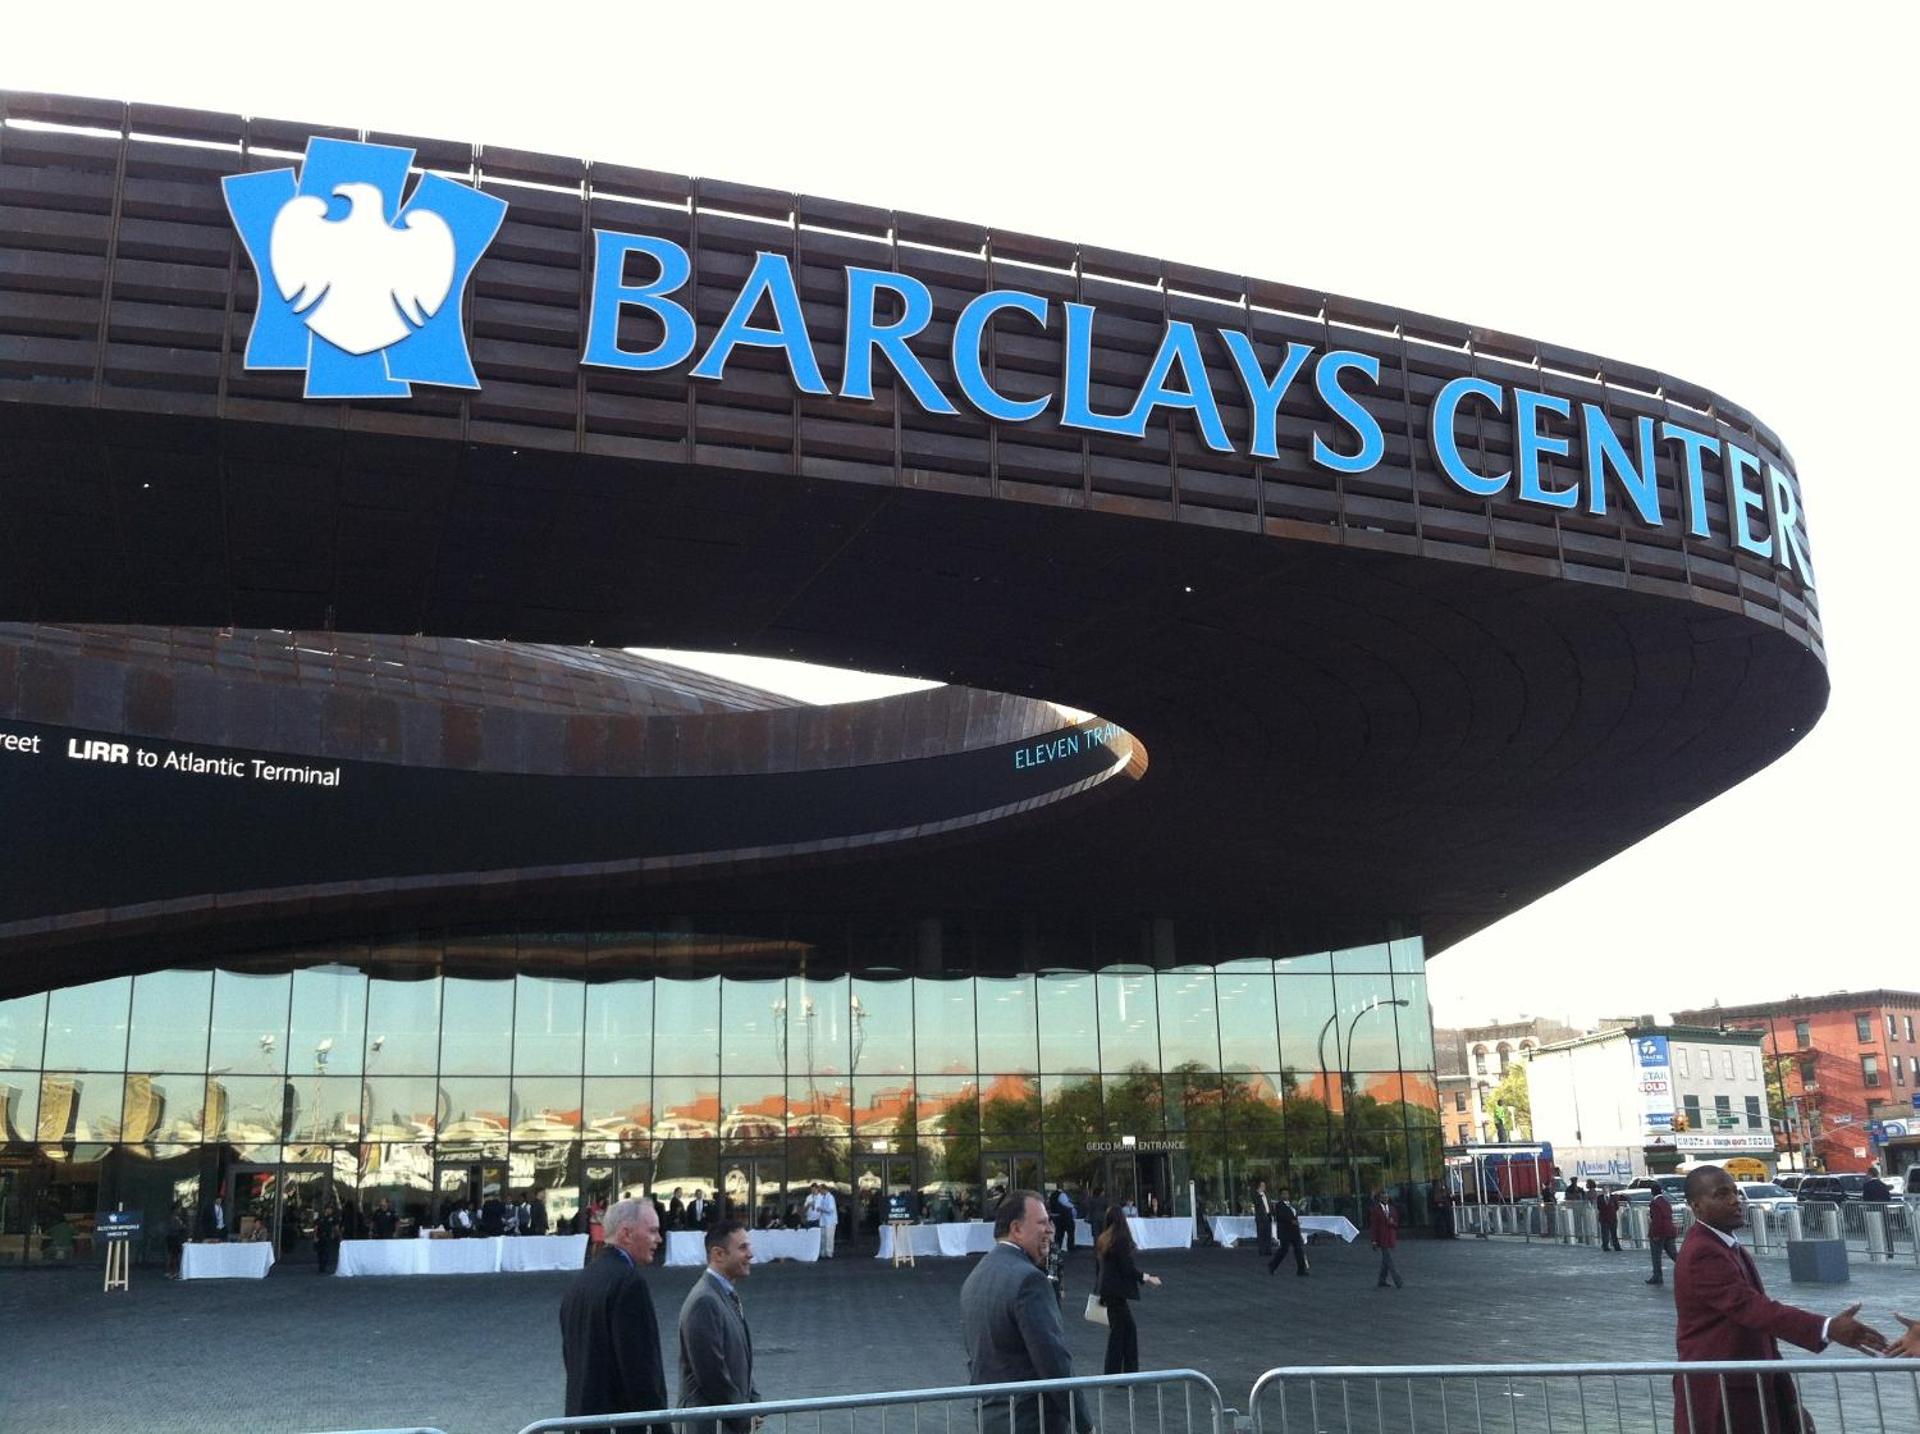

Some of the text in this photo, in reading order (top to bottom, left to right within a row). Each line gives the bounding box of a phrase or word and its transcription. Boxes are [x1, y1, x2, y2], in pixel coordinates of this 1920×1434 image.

[580, 228, 1815, 589] BARCLAYS CENTER
[67, 738, 129, 764] LIRR
[137, 748, 158, 767] to
[164, 751, 245, 777] Atlantic
[251, 760, 340, 786] Terminal
[1015, 735, 1079, 769] ELEVEN
[1086, 1141, 1112, 1151] GEICO
[1138, 1140, 1185, 1151] ENTRANCE
